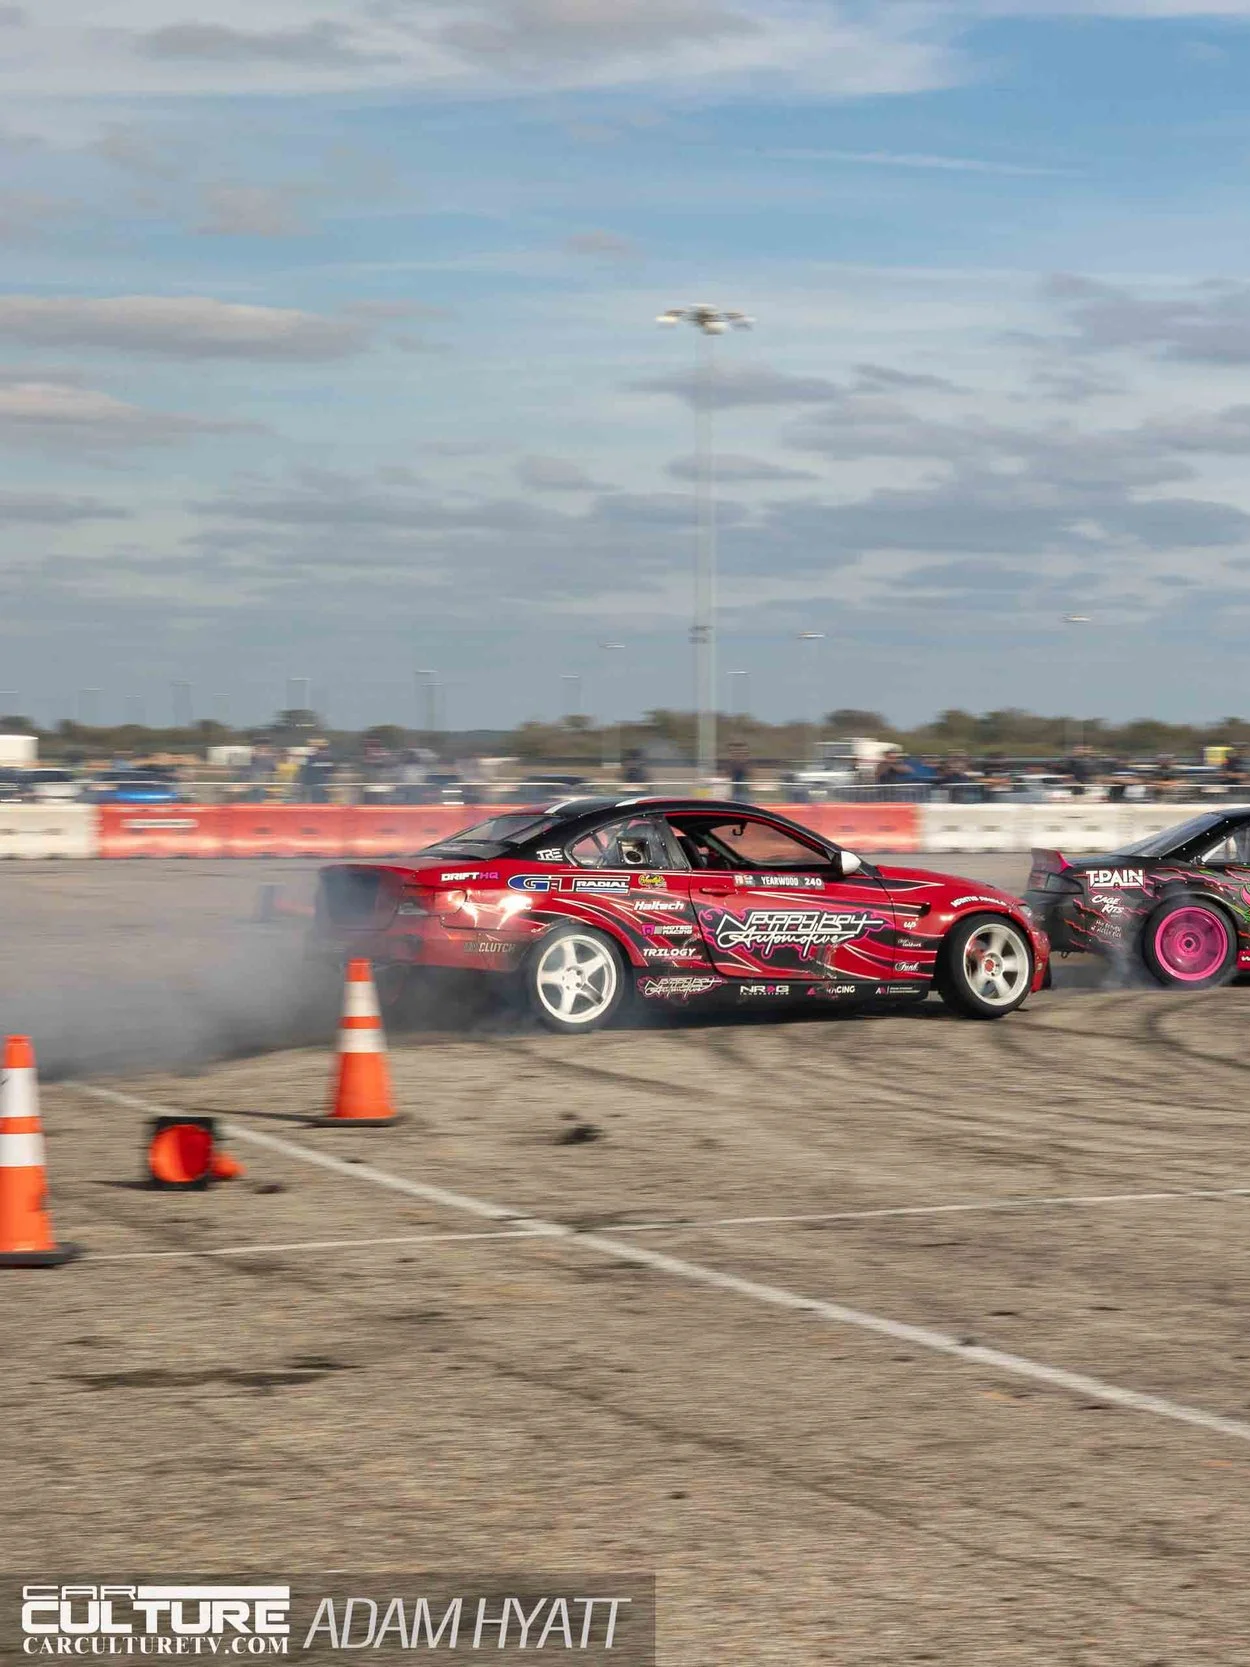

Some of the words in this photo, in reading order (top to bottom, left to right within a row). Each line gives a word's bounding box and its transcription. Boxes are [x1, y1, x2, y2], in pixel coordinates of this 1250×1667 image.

[508, 874, 592, 892] GT
[761, 876, 799, 886] YEARWOOD
[804, 877, 822, 886] 240
[634, 901, 685, 911] Haltech
[718, 926, 855, 957] Automotive
[479, 942, 516, 953] CLUTCH
[643, 948, 697, 957] TRILOGY
